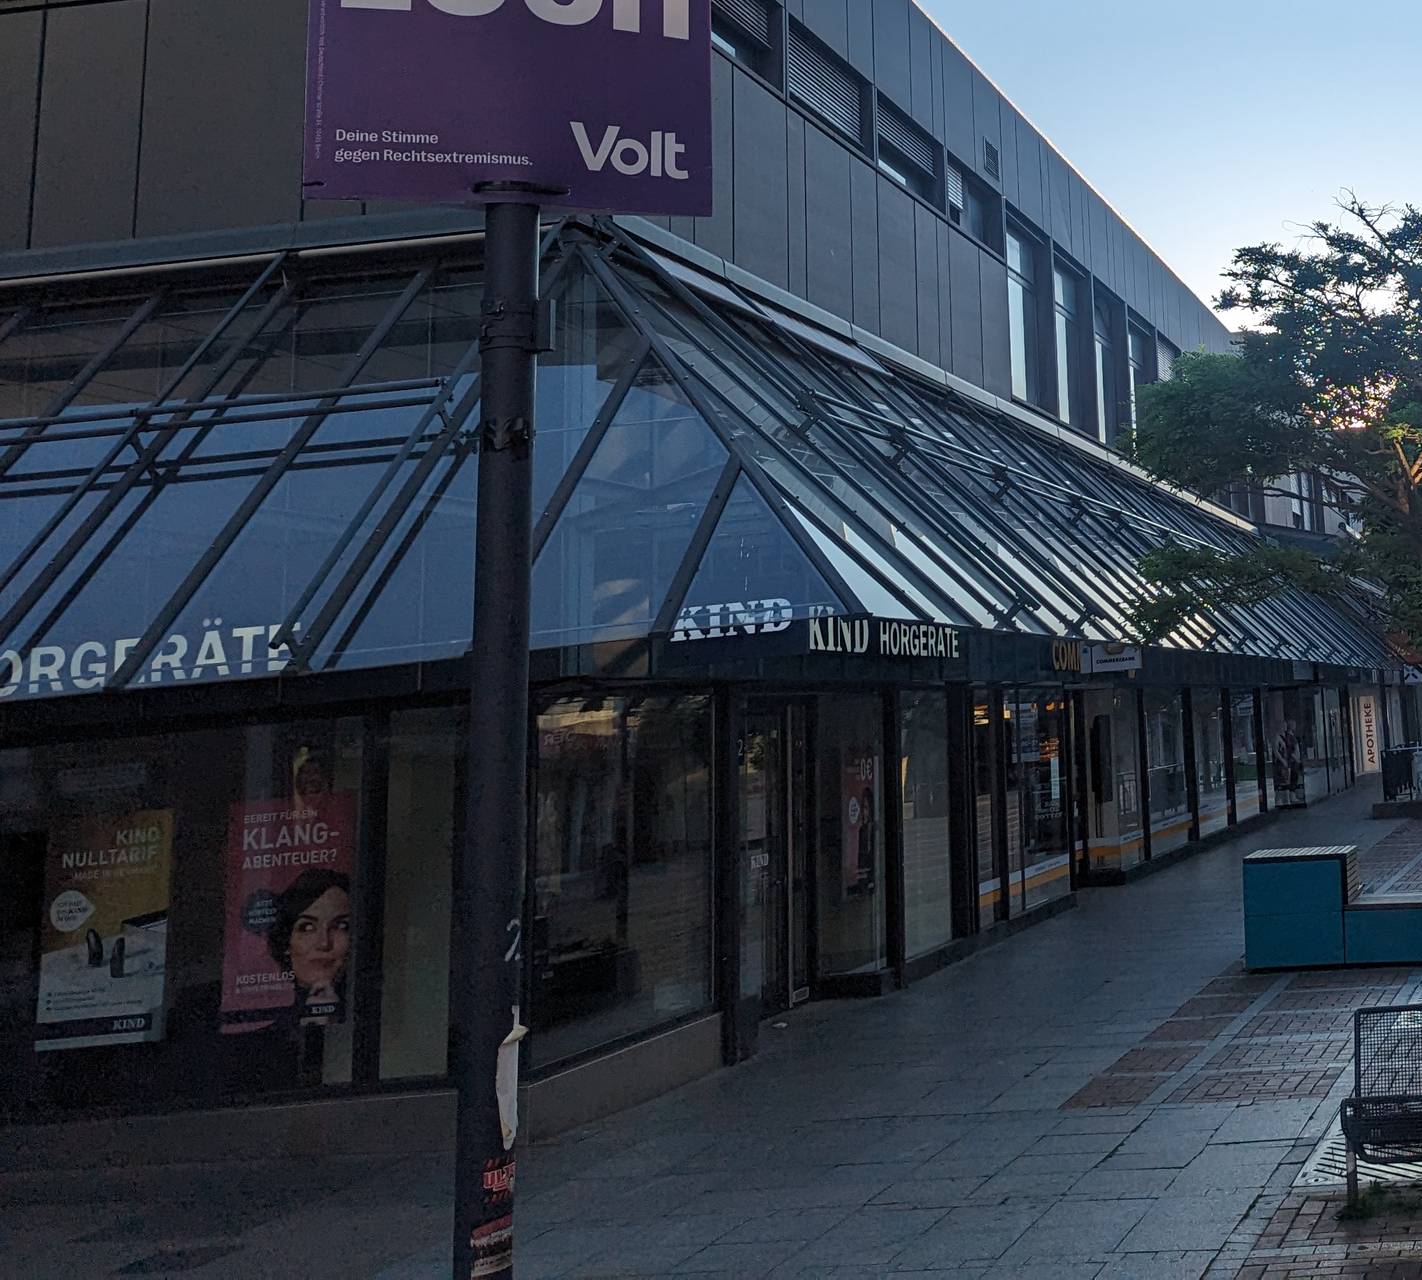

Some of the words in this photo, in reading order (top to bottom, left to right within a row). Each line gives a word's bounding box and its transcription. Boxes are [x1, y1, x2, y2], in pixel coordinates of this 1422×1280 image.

[336, 129, 378, 142] Deine
[382, 131, 439, 144] Stimme
[334, 148, 380, 163] gegen
[383, 149, 533, 166] Rechtsextremismus.
[570, 121, 689, 180] Volt
[670, 598, 793, 643] KIND
[808, 605, 869, 653] KIND
[1364, 703, 1375, 764] APOTHEKE
[116, 827, 160, 845] KIND
[243, 822, 340, 851] KLANG-
[61, 845, 158, 869] NULLTARIF
[242, 848, 337, 870] ABENTEUER?
[236, 971, 296, 985] KOSTENLOS
[111, 1018, 145, 1031] KIND
